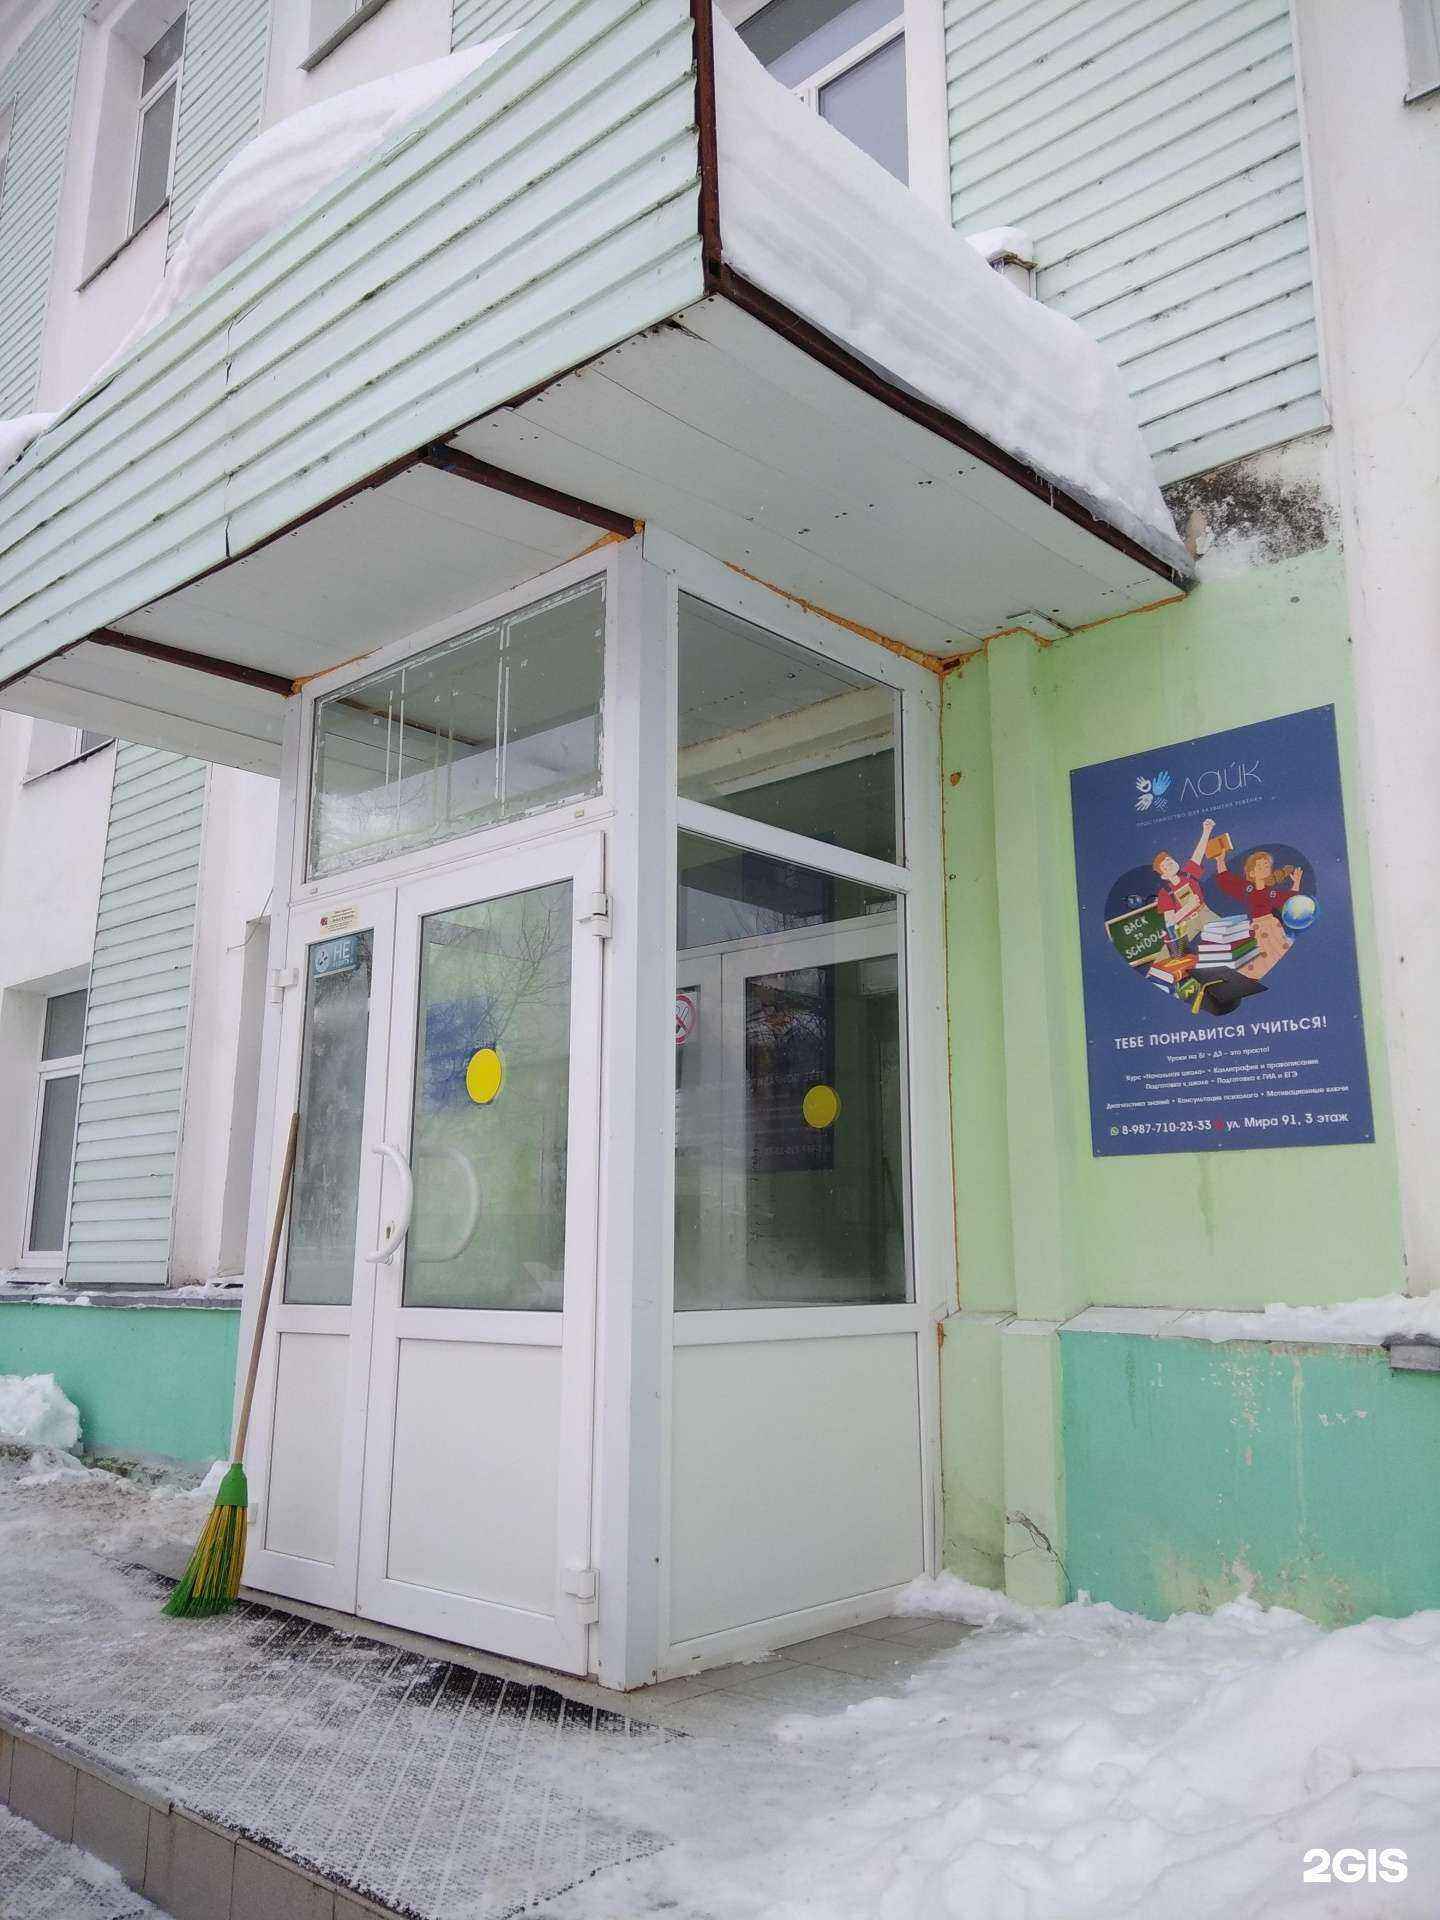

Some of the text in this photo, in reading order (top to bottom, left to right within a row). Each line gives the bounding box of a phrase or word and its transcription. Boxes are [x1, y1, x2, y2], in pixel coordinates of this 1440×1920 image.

[1123, 916, 1149, 935] BACK
[1126, 930, 1165, 959] SCHOOL
[1134, 932, 1144, 940] TO
[1114, 1015, 1327, 1050] ТЕБЕ ПОНРАВИТСЯ УЧИТЬСЯ!
[1166, 1055, 1188, 1063] Уроки
[1242, 1046, 1270, 1057] просто!
[1284, 1071, 1298, 1079] ЕГЭ
[1122, 1112, 1349, 1136] 8-987-710-23-33 ул. Мира 91, 3 этаж
